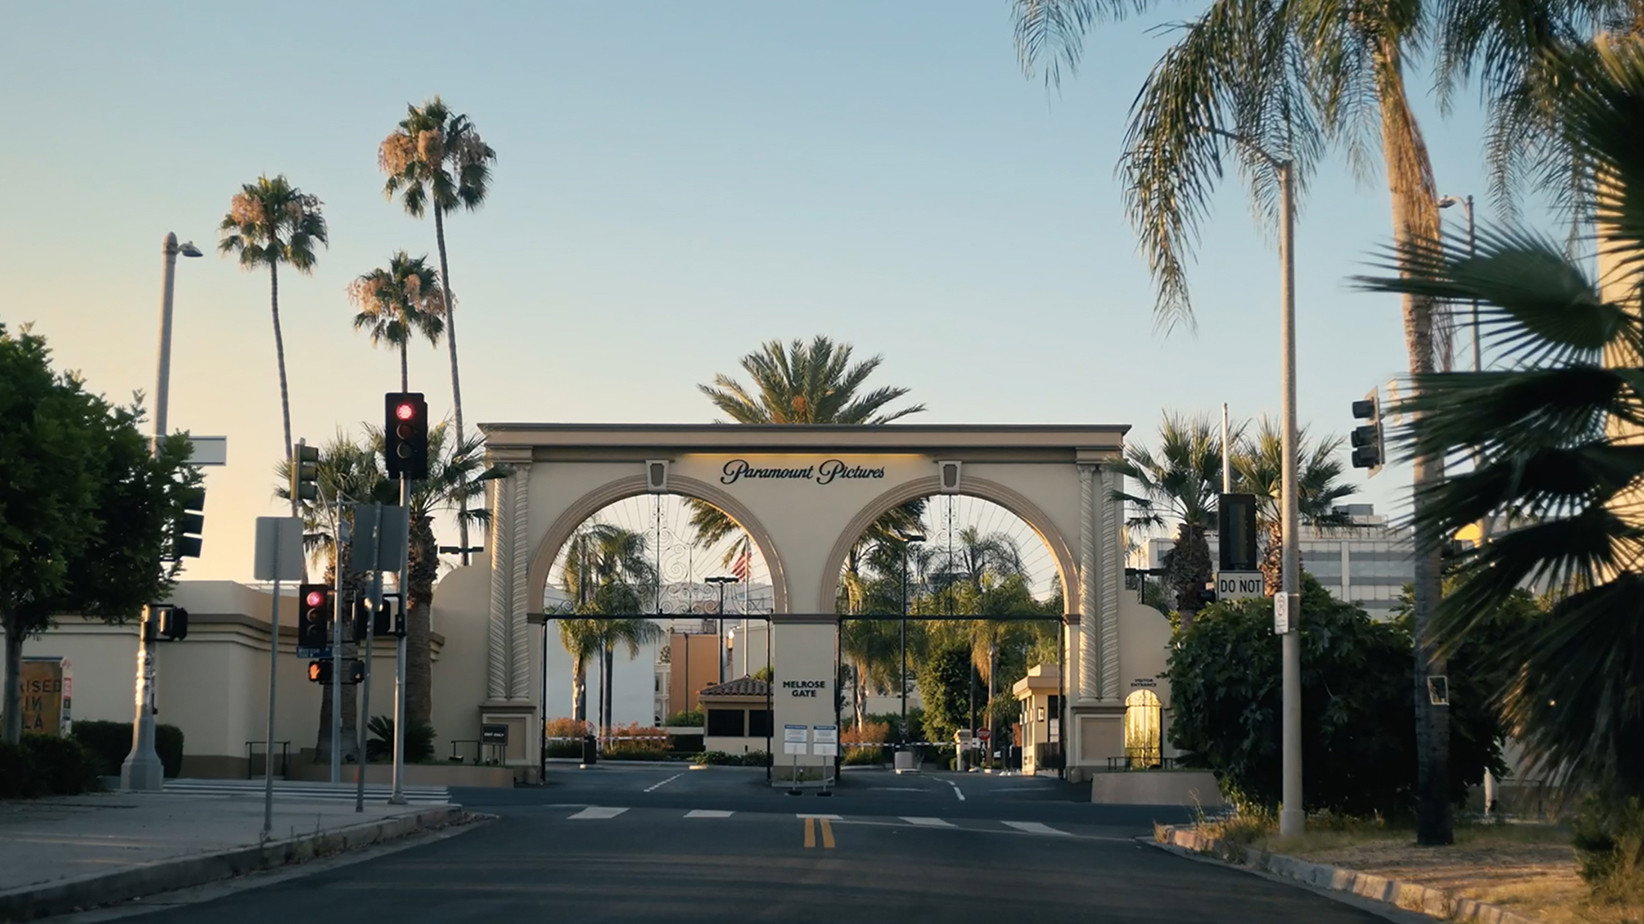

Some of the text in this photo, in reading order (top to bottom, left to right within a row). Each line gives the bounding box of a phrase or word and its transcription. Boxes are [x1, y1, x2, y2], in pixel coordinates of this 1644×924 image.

[720, 459, 885, 485] Paramount Pictures
[1220, 579, 1261, 593] DO NOT
[19, 679, 62, 694] ISED
[783, 680, 826, 689] MELROSE
[792, 689, 817, 698] GATE
